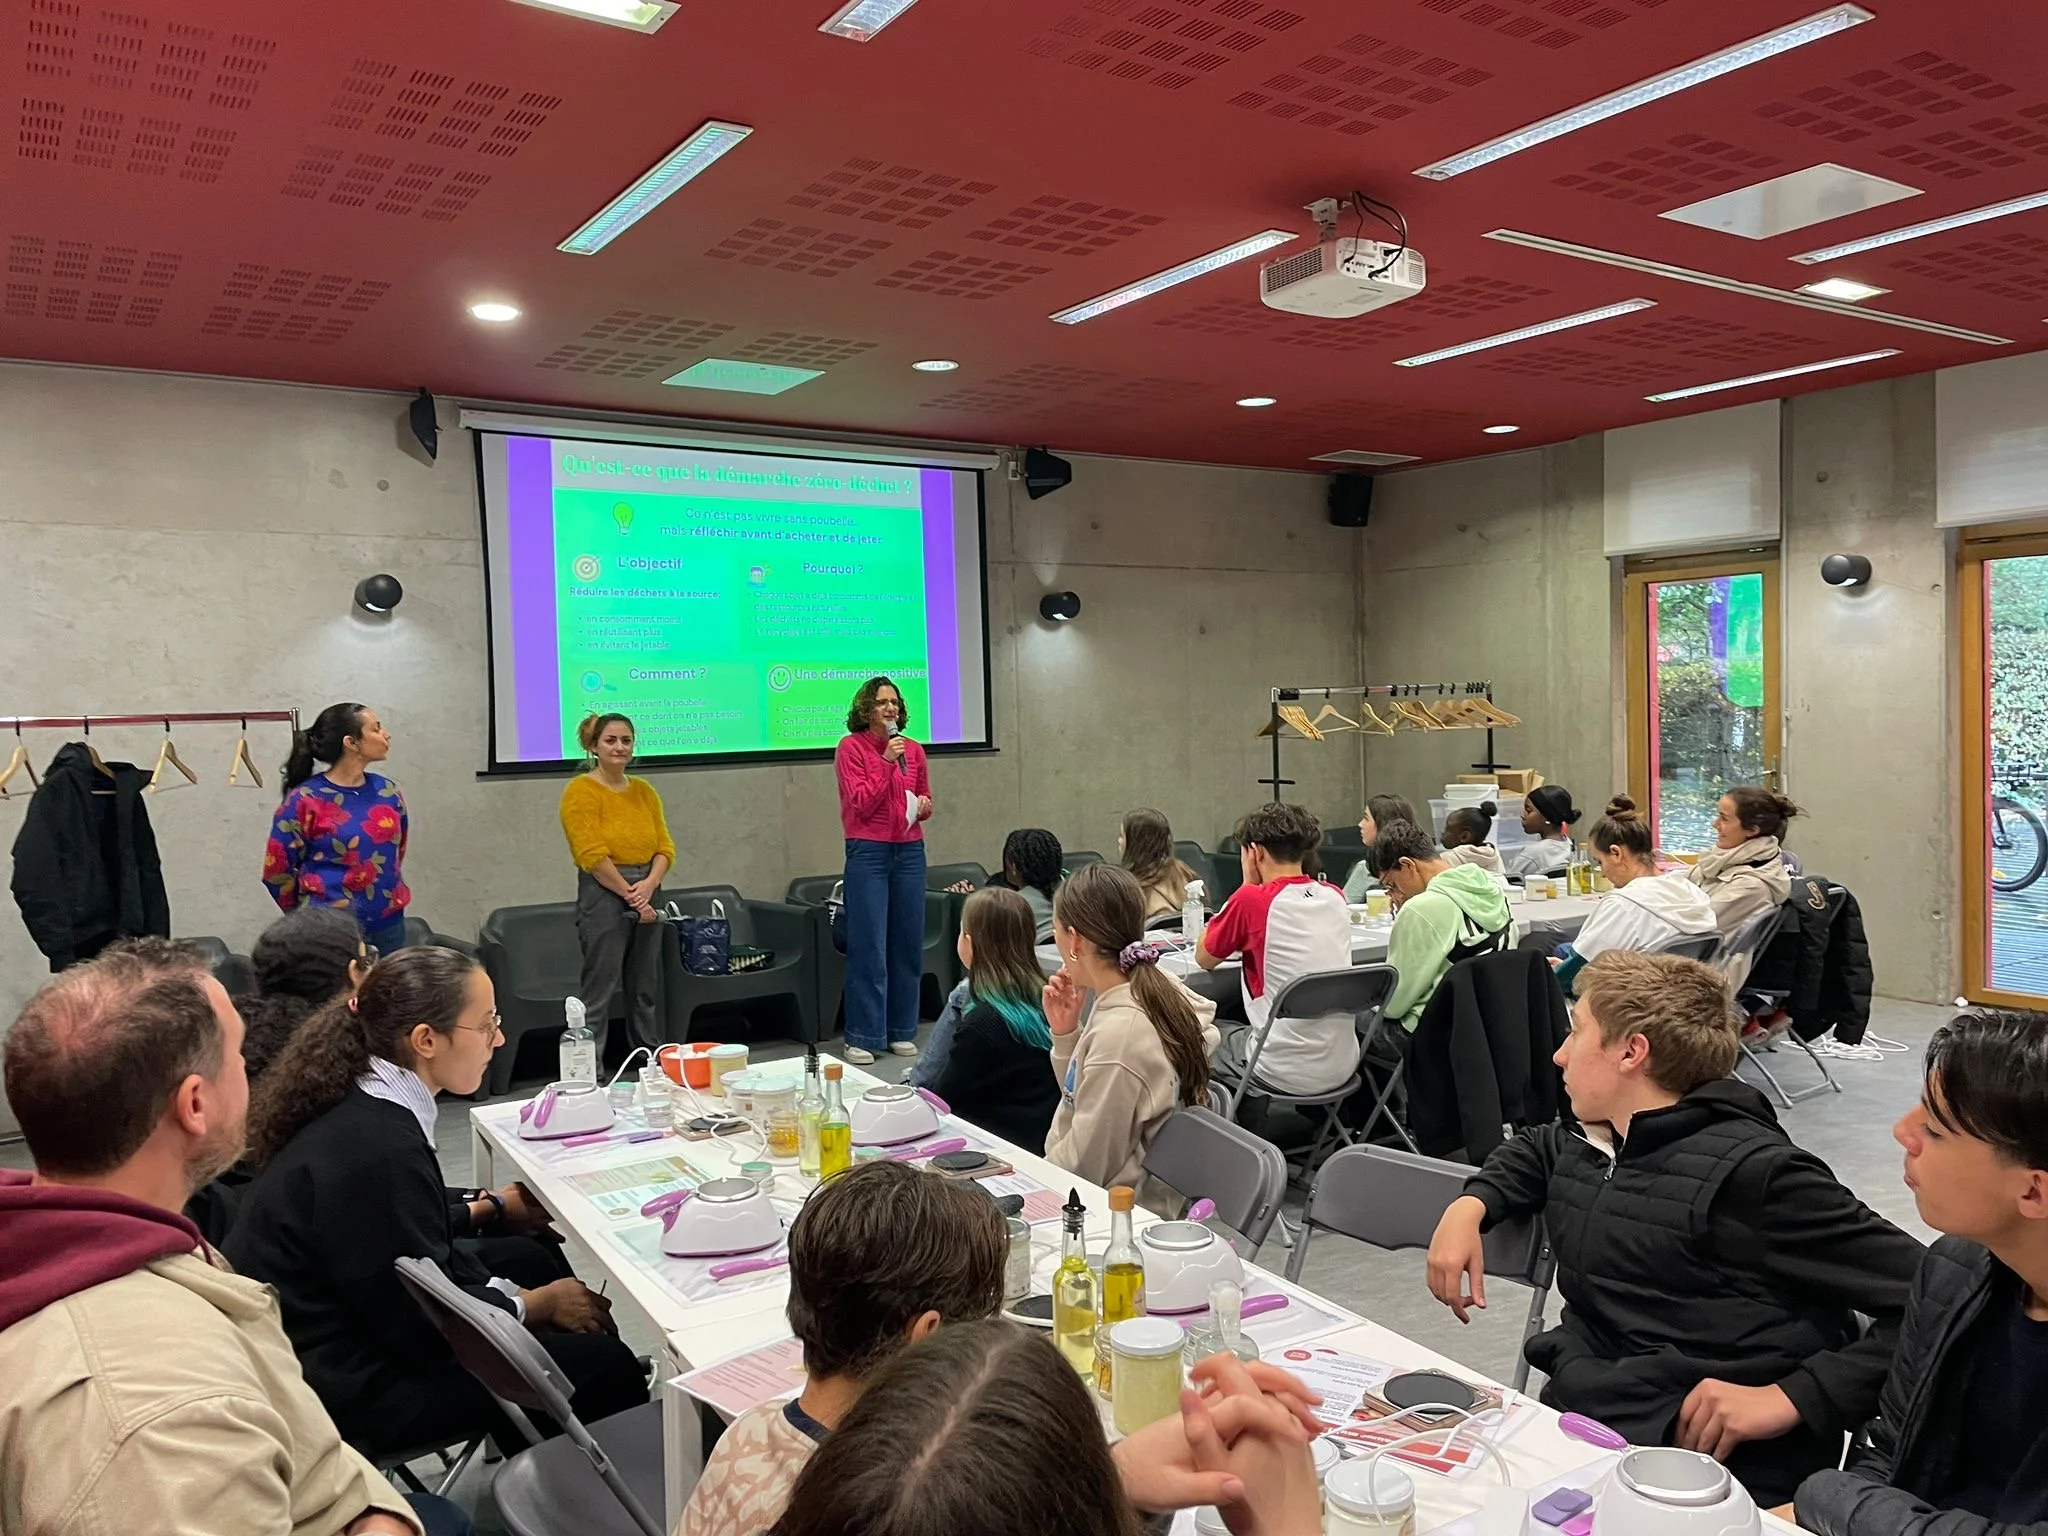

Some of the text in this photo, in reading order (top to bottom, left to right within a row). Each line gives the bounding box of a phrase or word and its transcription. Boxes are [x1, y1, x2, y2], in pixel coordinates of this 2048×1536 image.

[562, 454, 913, 494] Qu'est-ce que la démarche zéro-déchet ?
[685, 507, 700, 519] Ce
[703, 509, 730, 520] n'est
[734, 511, 753, 522] pas
[755, 511, 780, 522] vivre
[784, 513, 807, 524] sans
[660, 525, 687, 535] mais
[690, 526, 738, 538] réfléchir
[741, 530, 772, 540] avant
[775, 530, 826, 542] d'acheter
[829, 533, 840, 542] et
[843, 532, 856, 543] de
[618, 556, 682, 570] L'objectif
[803, 562, 864, 576] Pourquoi ?
[569, 587, 609, 597] Réduire
[610, 587, 625, 596] les
[627, 588, 666, 597] déchets
[669, 589, 675, 597] à
[677, 589, 685, 598] la
[628, 667, 706, 680] Comment ?
[794, 668, 926, 679] Une démarche positive
[589, 701, 601, 709] En
[639, 699, 662, 708] avant
[652, 711, 673, 720] dont
